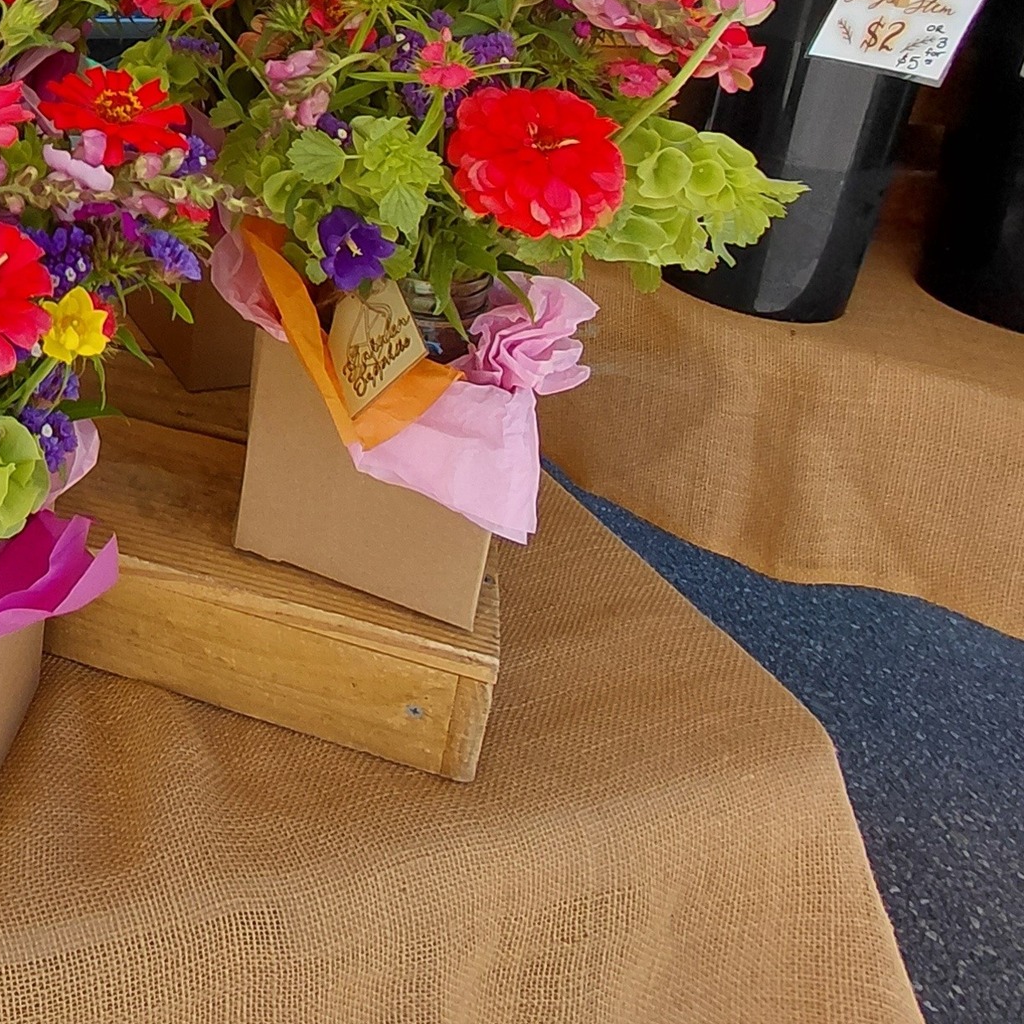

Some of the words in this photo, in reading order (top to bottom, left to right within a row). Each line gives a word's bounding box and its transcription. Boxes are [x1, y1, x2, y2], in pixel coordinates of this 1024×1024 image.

[926, 24, 945, 33] OR
[860, 16, 906, 53] $2
[936, 37, 948, 49] 3
[924, 47, 946, 57] for
